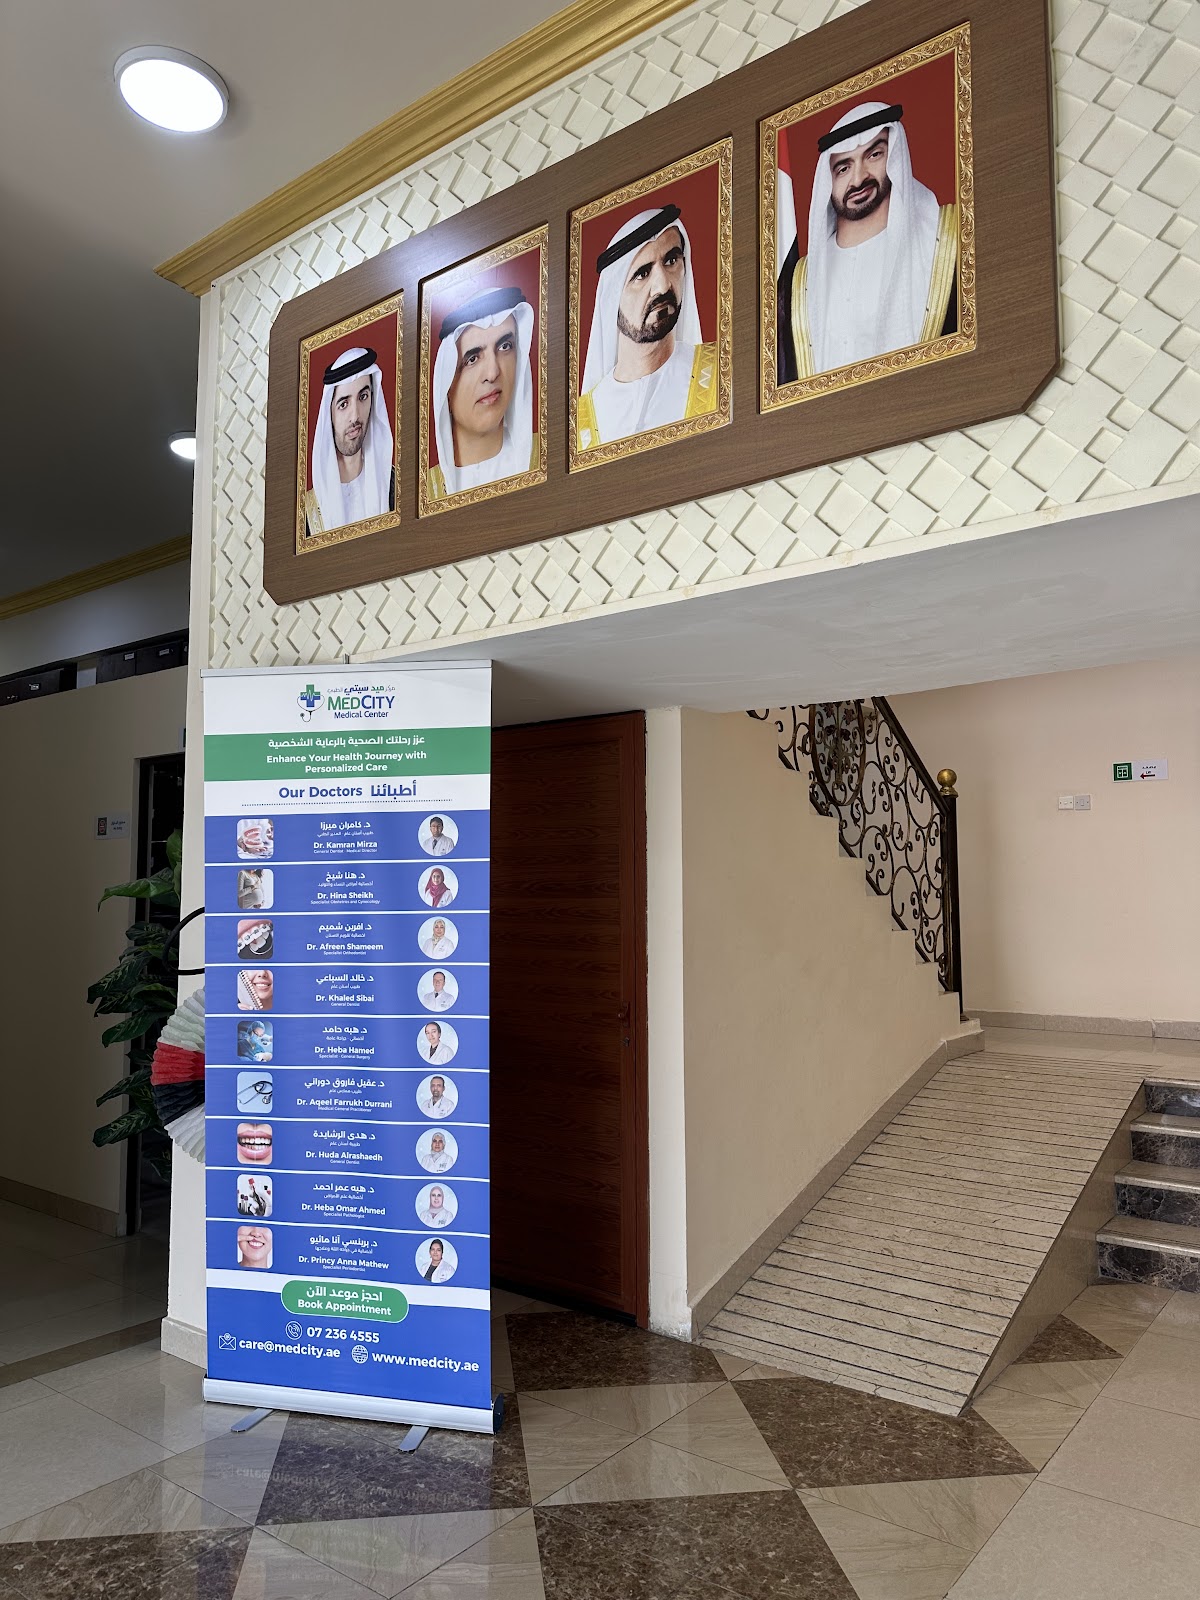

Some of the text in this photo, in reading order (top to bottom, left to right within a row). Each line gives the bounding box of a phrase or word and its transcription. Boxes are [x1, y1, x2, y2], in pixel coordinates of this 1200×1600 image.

[344, 685, 368, 695] سيتي
[371, 685, 384, 693] ميد
[328, 695, 395, 710] MEDCITY
[364, 710, 388, 718] Center
[268, 735, 425, 749] عزز رحلتك الصحية بالرعاية الشخصية
[266, 750, 427, 763] Enhance Your Health Journey with
[305, 763, 388, 773] Personalized Care
[279, 786, 363, 798] Our Doctors
[371, 780, 417, 800] أطبائنا
[321, 822, 337, 830] ميرزا
[339, 821, 361, 830] كامران
[326, 871, 342, 881] شيخ
[319, 922, 342, 932] شميم
[345, 922, 363, 931] افرين
[316, 974, 348, 984] السباعي
[304, 1078, 330, 1088] دوراني
[333, 1078, 355, 1088] فاروق
[357, 1079, 376, 1088] عقيل
[365, 1100, 392, 1108] Durrani
[313, 1130, 345, 1139] الرشايدة
[348, 1132, 367, 1140] هدى
[341, 1152, 382, 1161] Alrashaedh
[313, 1183, 333, 1191] احمد
[351, 1185, 366, 1193] هبه
[359, 1206, 385, 1215] Ahmed
[332, 1235, 340, 1244] آنا
[311, 1257, 335, 1265] Princy
[359, 1260, 389, 1269] Mathew
[307, 1286, 382, 1302] احجز موعد الآن
[298, 1299, 391, 1315] Book Appointment
[307, 1327, 380, 1343] 07 236 4555
[239, 1339, 340, 1358] care@medcity.ae
[372, 1352, 479, 1372] www.medcity.ae
